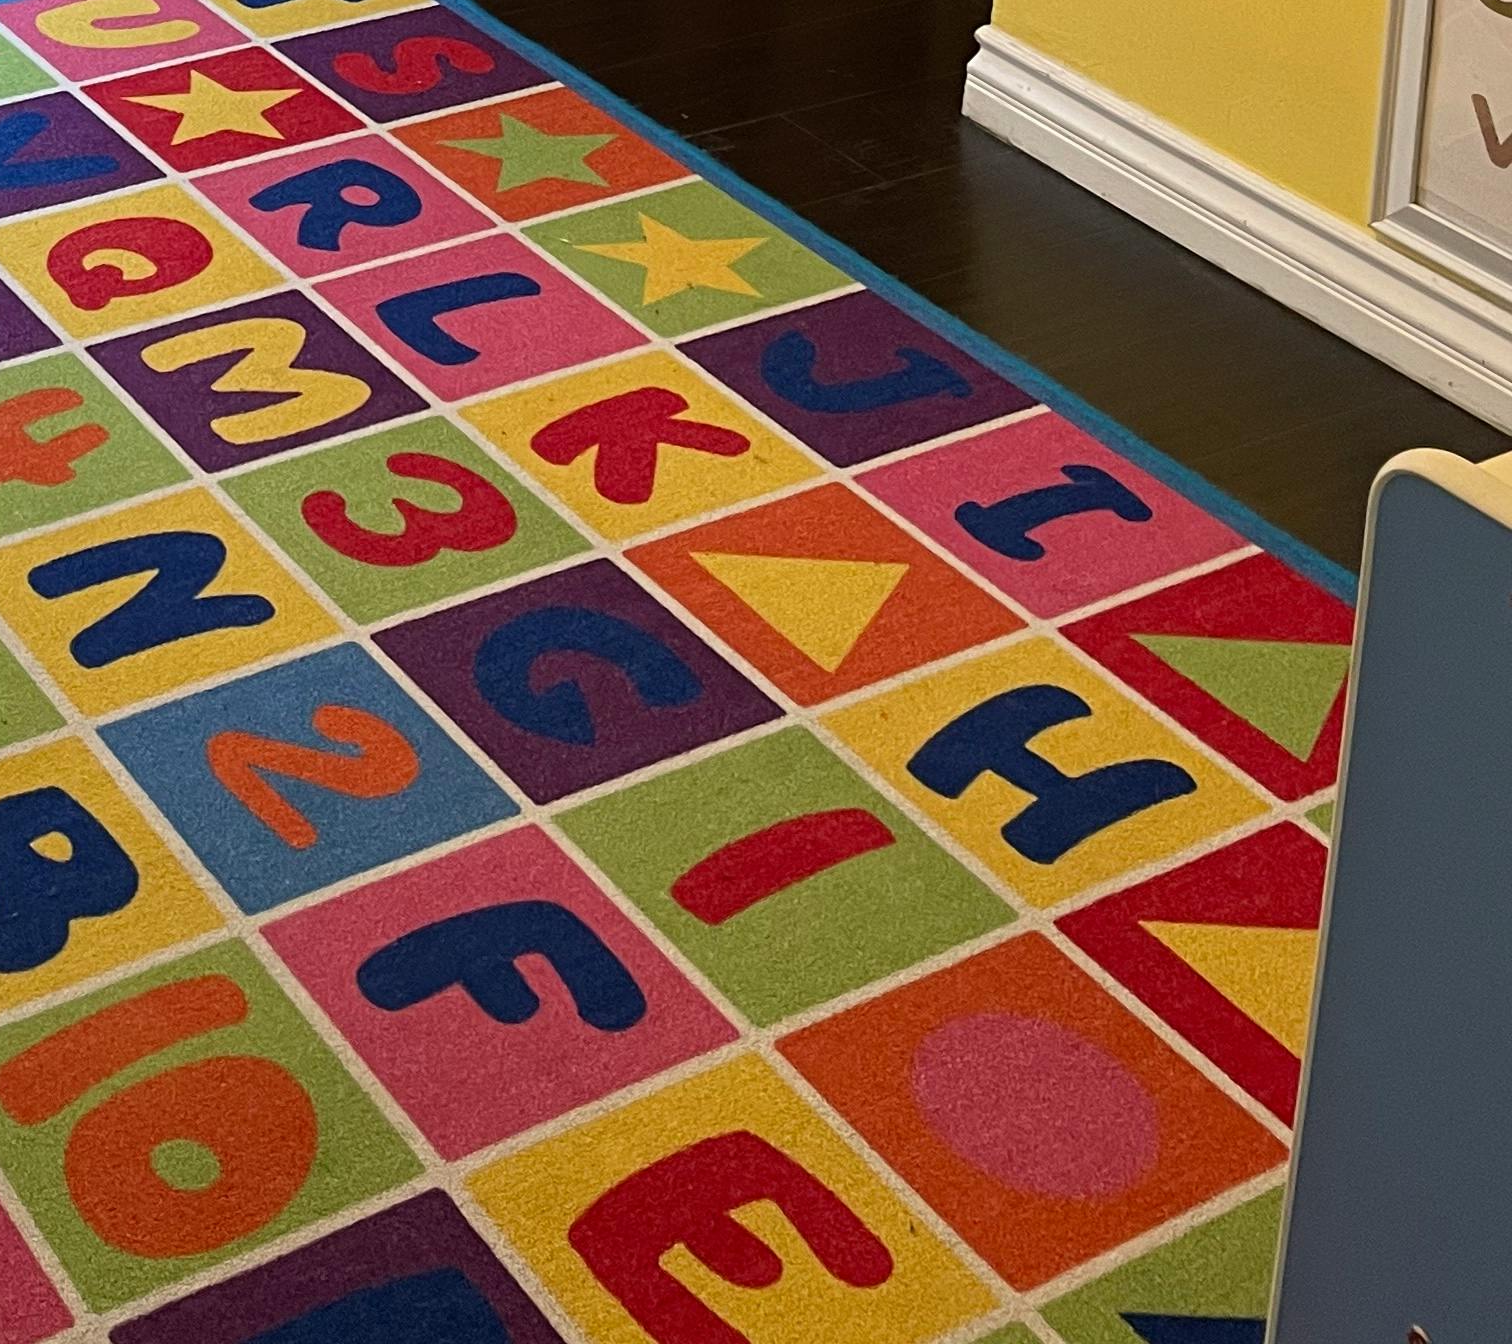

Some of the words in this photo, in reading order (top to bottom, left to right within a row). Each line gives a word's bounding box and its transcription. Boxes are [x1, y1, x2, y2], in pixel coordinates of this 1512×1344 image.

[333, 36, 496, 95] S
[47, 216, 214, 310] Q
[249, 158, 422, 251] R
[376, 272, 542, 366] L
[761, 331, 972, 414] J
[140, 317, 372, 445] M
[530, 385, 751, 505] K
[301, 452, 517, 567] 3
[954, 464, 1153, 560] I
[27, 530, 276, 668] N
[474, 607, 702, 747] G
[206, 704, 420, 850] 2
[906, 683, 1197, 865] H
[356, 900, 647, 1032] F
[568, 1130, 894, 1344] E
